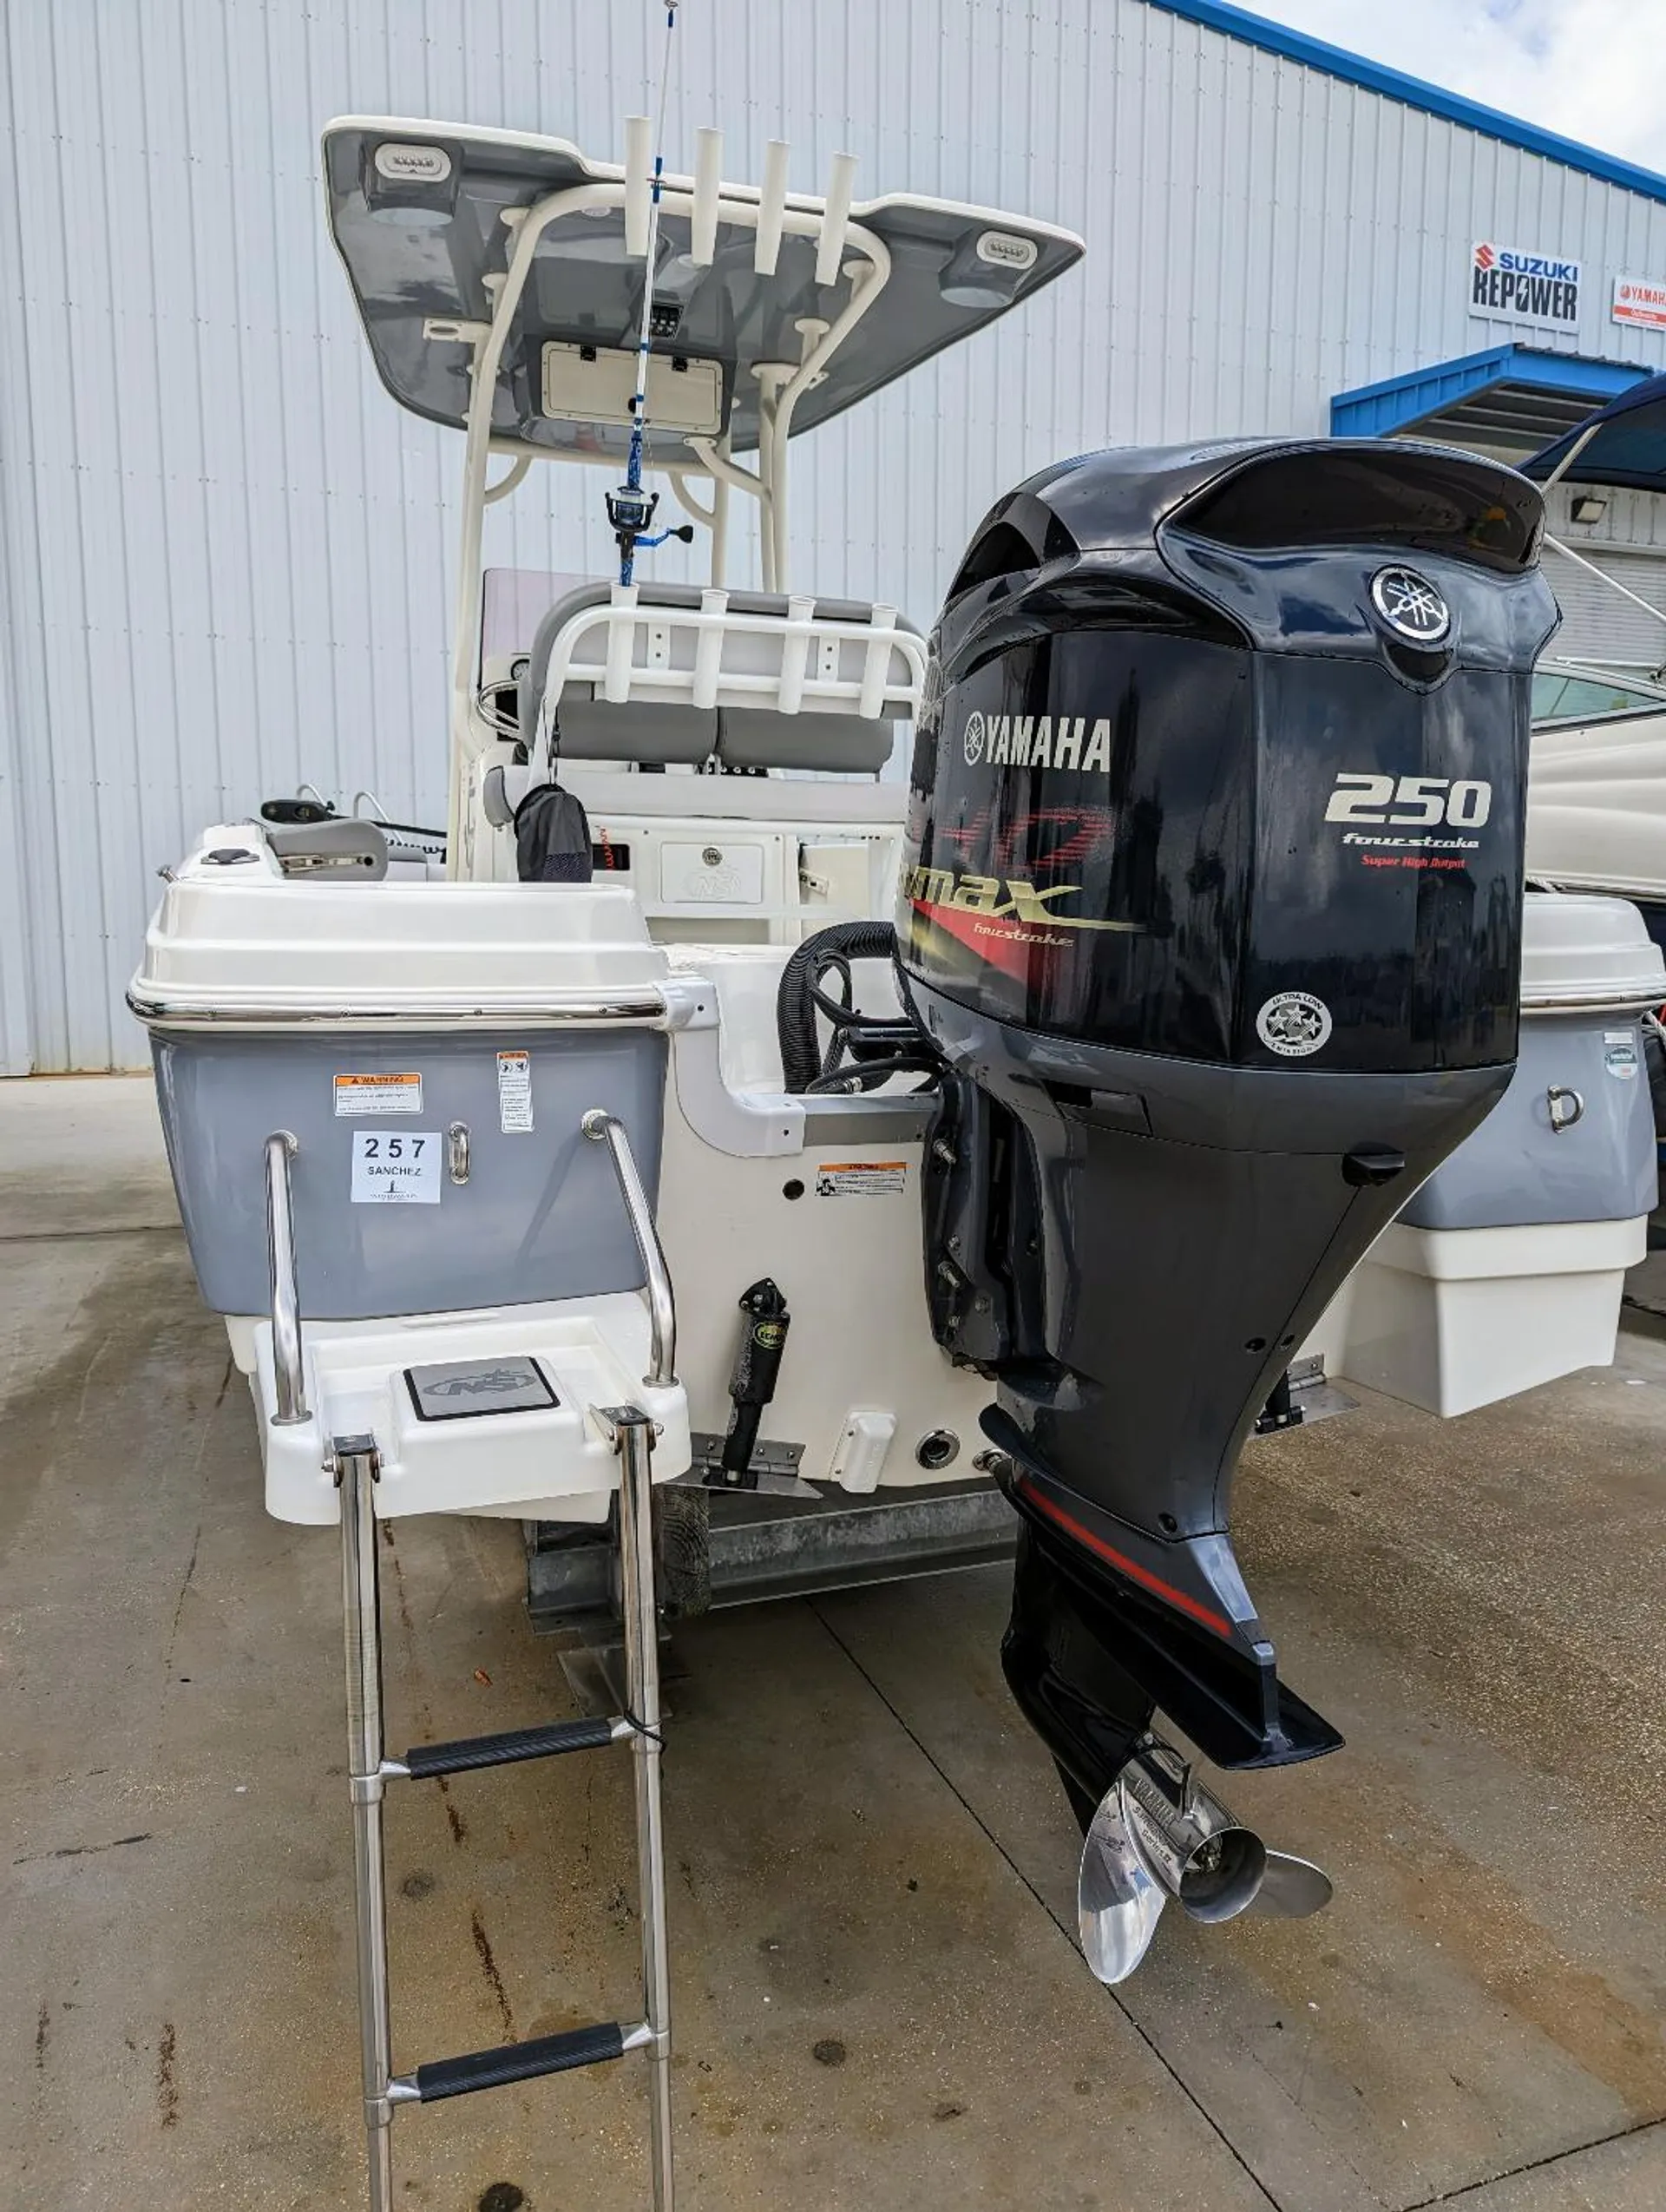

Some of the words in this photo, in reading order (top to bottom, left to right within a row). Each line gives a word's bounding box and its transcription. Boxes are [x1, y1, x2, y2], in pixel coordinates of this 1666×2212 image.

[1499, 253, 1578, 283] SUZUKI
[1473, 266, 1578, 321] REPOWER
[985, 715, 1112, 773] YAMAHA
[1325, 772, 1492, 828] 250
[1361, 854, 1400, 867] Super
[1401, 856, 1429, 869] High
[367, 1165, 422, 1177] SANCHEZ
